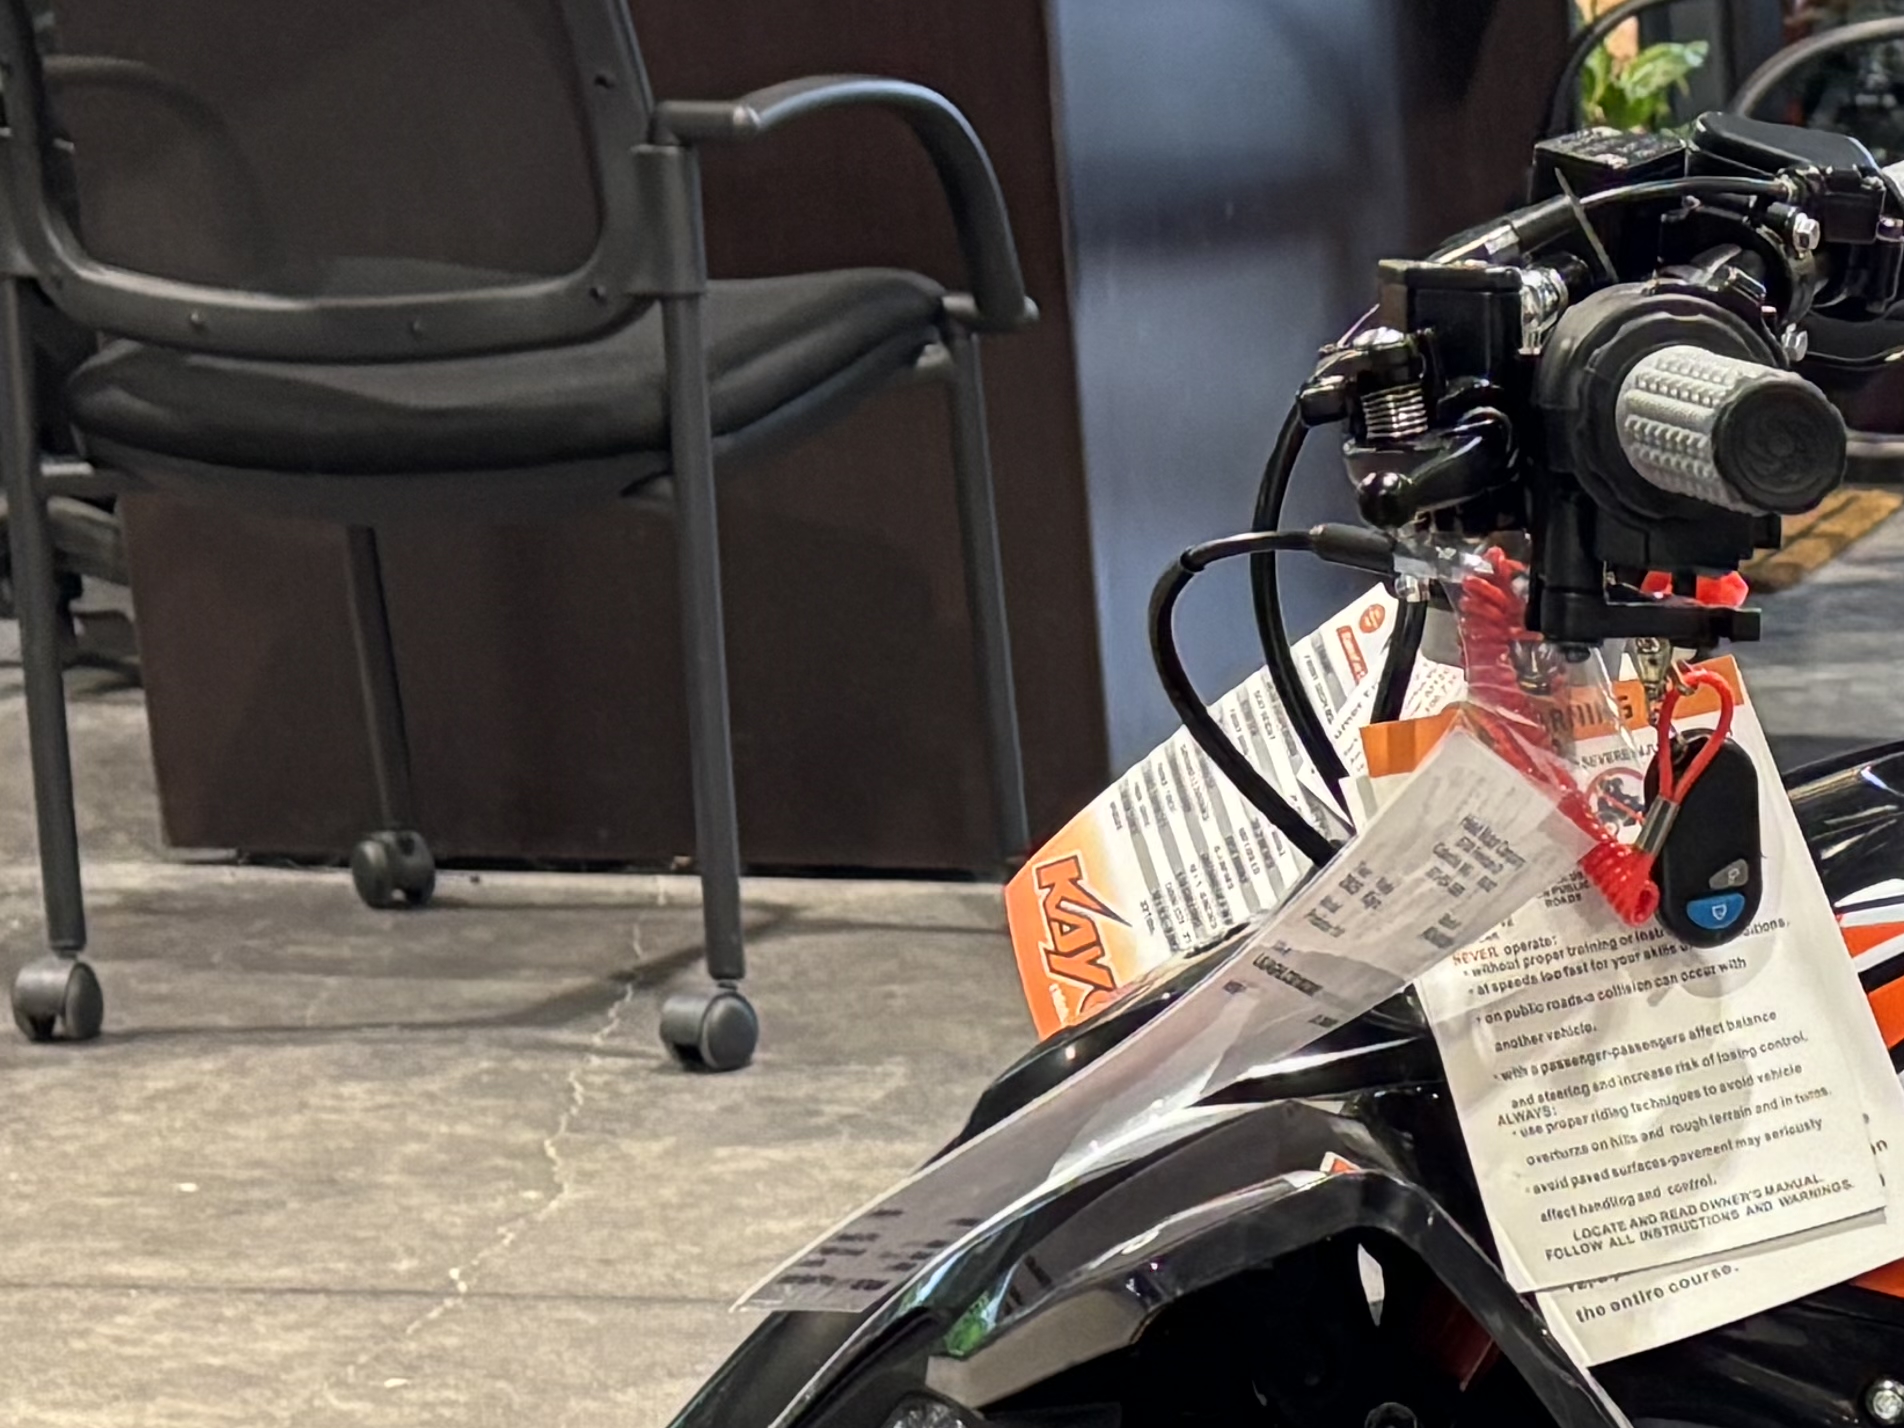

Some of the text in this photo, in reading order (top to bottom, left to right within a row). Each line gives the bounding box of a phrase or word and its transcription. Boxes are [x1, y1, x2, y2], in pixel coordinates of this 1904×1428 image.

[1452, 935, 1558, 967] NEVER operate:
[1523, 948, 1565, 970] proper
[1485, 1011, 1503, 1025] on
[1504, 1000, 1545, 1023] public
[1596, 978, 1653, 1001] collision
[1653, 973, 1679, 988] can
[1681, 965, 1717, 983] occur
[1719, 956, 1747, 973] with
[1492, 974, 1539, 994] speeds
[1495, 1029, 1544, 1053] another
[1500, 1064, 1528, 1082] with
[1688, 1021, 1726, 1041] affect
[1726, 1010, 1777, 1032] balance
[1511, 1093, 1535, 1109] and
[1537, 1082, 1591, 1105] steering
[1592, 1076, 1617, 1092] and
[1675, 1056, 1700, 1075] risk
[1520, 1123, 1544, 1138] use
[1545, 1115, 1589, 1135] proper
[1630, 1087, 1702, 1113] techniques
[1702, 1083, 1718, 1097] to
[1719, 1074, 1755, 1094] avoid
[1756, 1063, 1803, 1084] vehicle
[1591, 1137, 1609, 1153] on
[1640, 1125, 1665, 1143] and
[1669, 1115, 1709, 1135] rough
[1709, 1105, 1753, 1125] terrain
[1754, 1097, 1779, 1115] and
[1570, 1167, 1611, 1189] paved
[1764, 1117, 1823, 1142] seriously
[1540, 1206, 1578, 1223] affect
[1578, 1194, 1636, 1216] handling
[1636, 1186, 1662, 1203] and
[1544, 1239, 1604, 1262] FOLLOW
[1608, 1234, 1636, 1249] ALL
[1639, 1209, 1740, 1242] INSTRUCTIONS
[1745, 1200, 1774, 1217] AND
[1572, 1218, 1628, 1242] LOCATE
[1628, 1212, 1658, 1230] AND
[1659, 1204, 1698, 1222] READ
[1575, 1263, 1741, 1324] the entire course.
